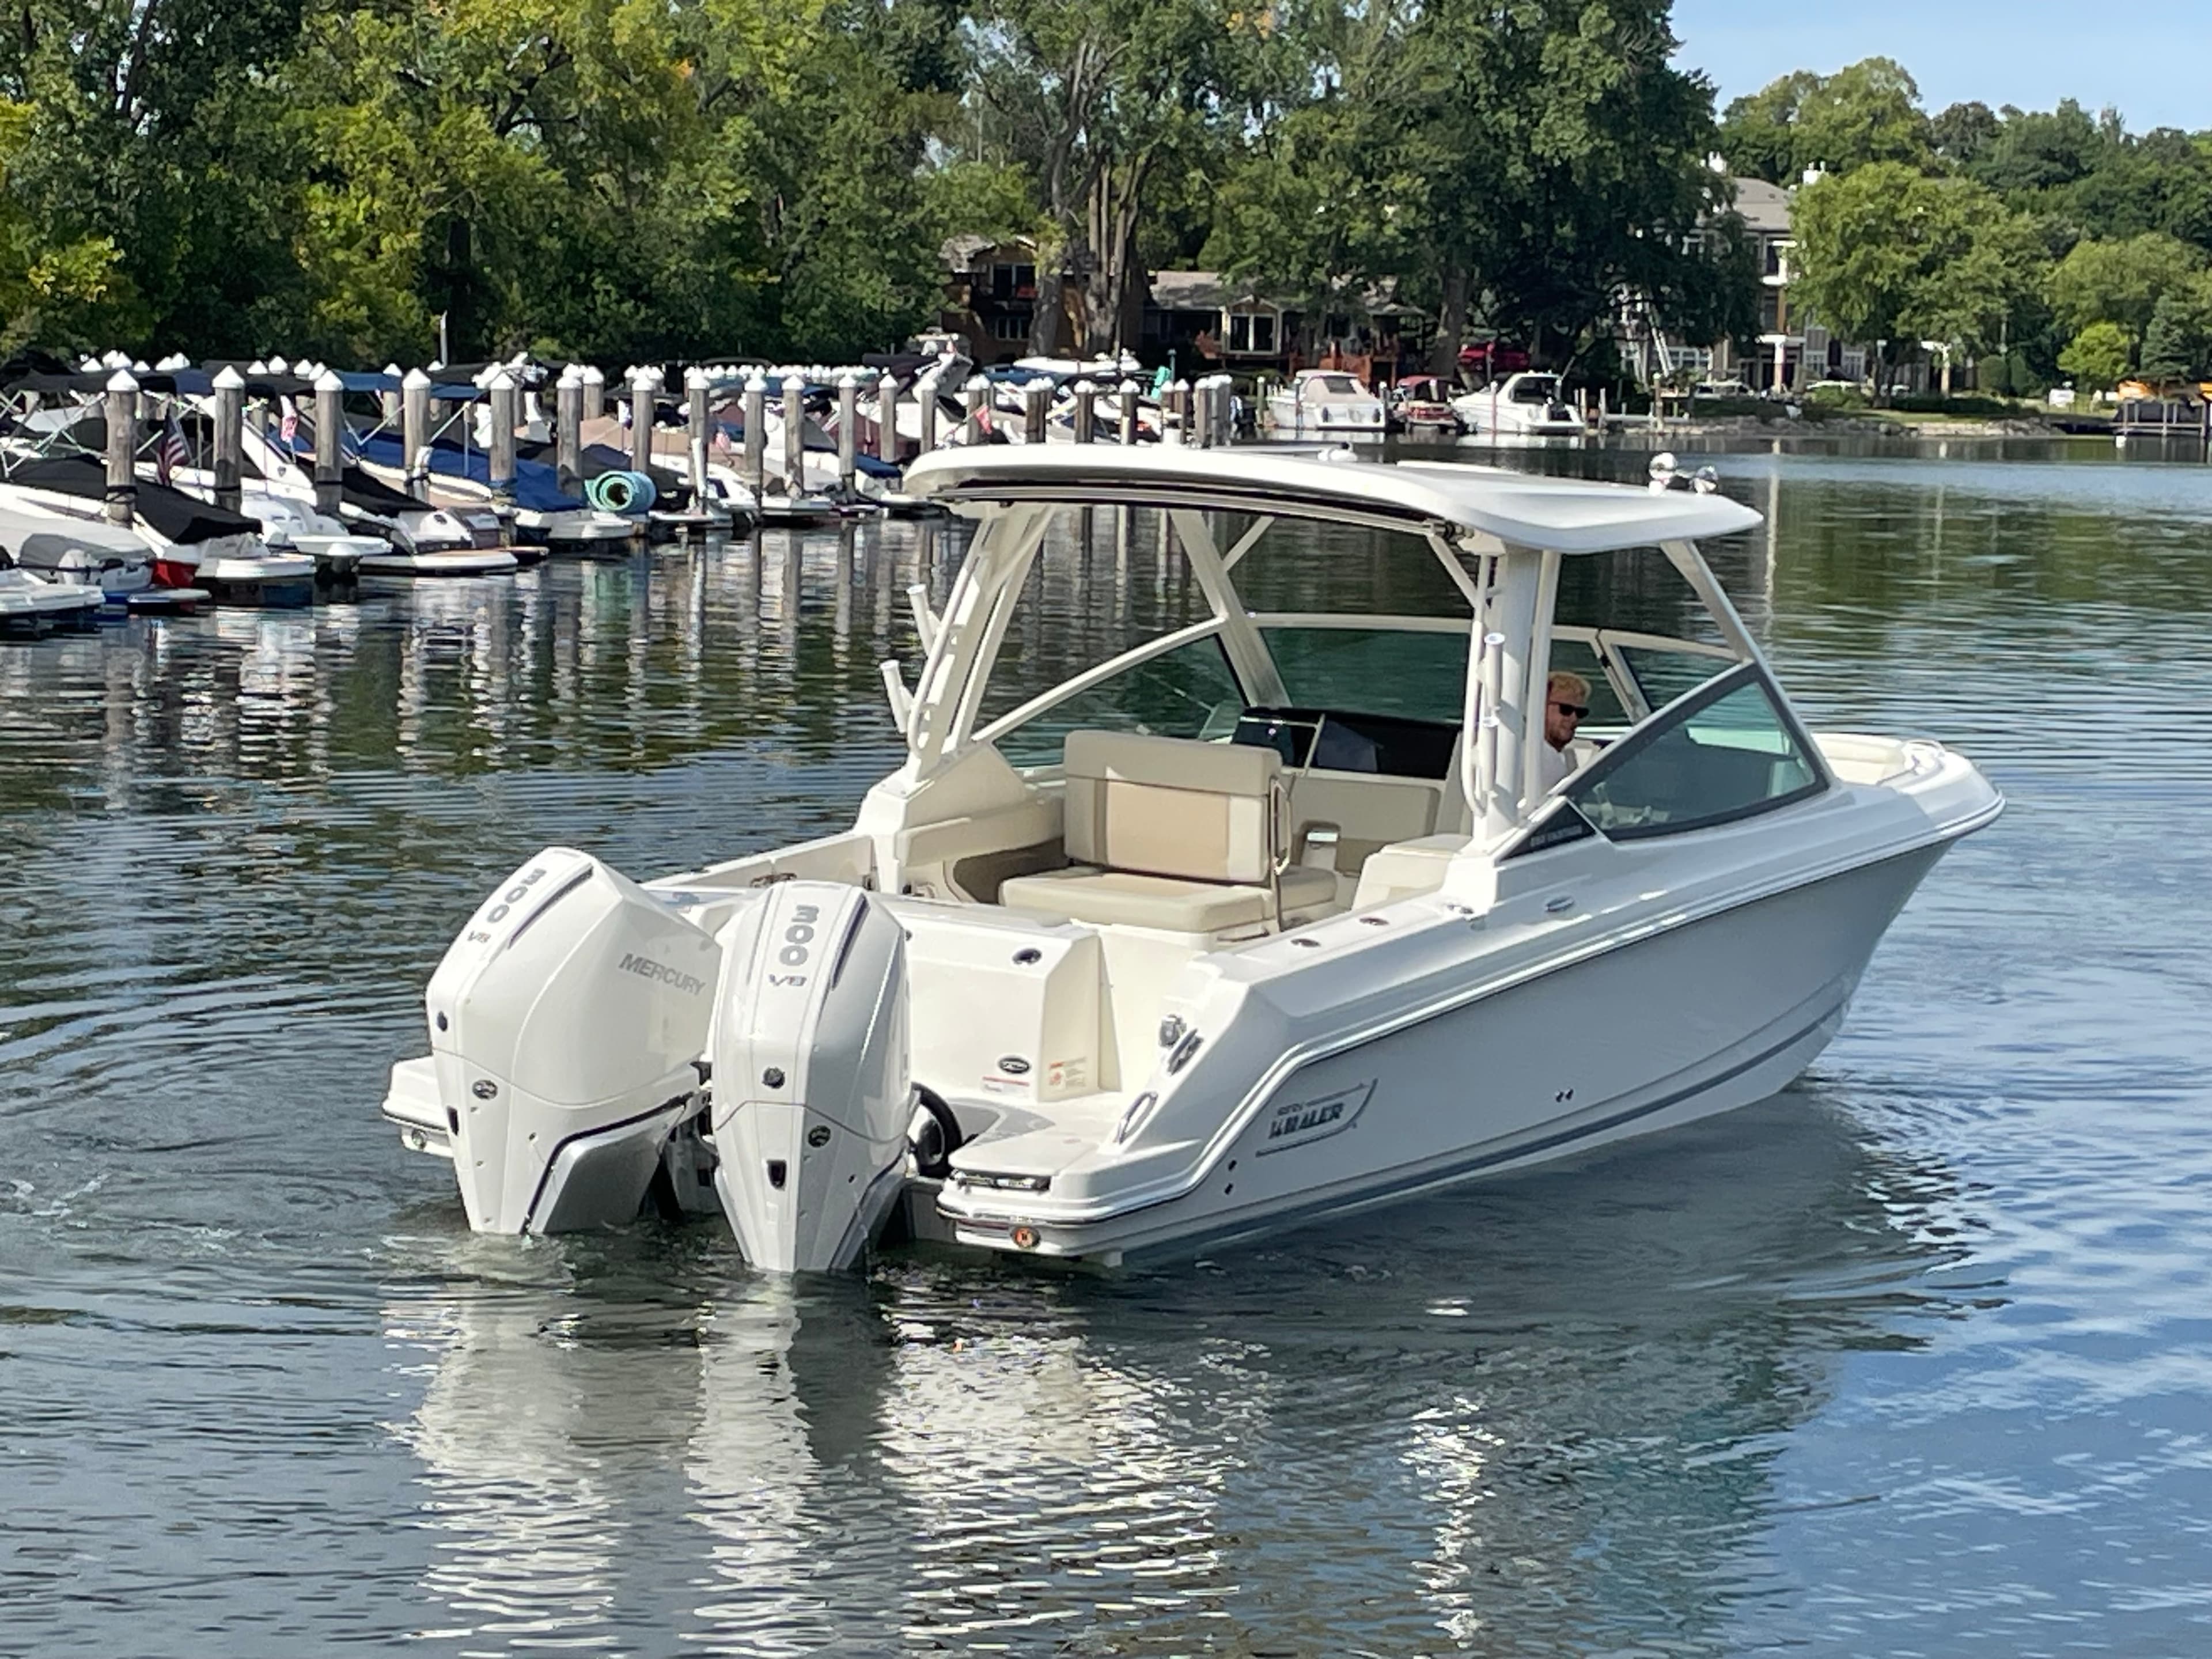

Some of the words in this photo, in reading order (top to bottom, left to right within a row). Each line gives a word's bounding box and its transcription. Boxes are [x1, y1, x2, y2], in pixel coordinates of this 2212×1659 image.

[487, 869, 547, 923] 300
[779, 905, 819, 966] 300
[618, 953, 706, 996] MERCURY
[1268, 1102, 1344, 1139] WHALER
